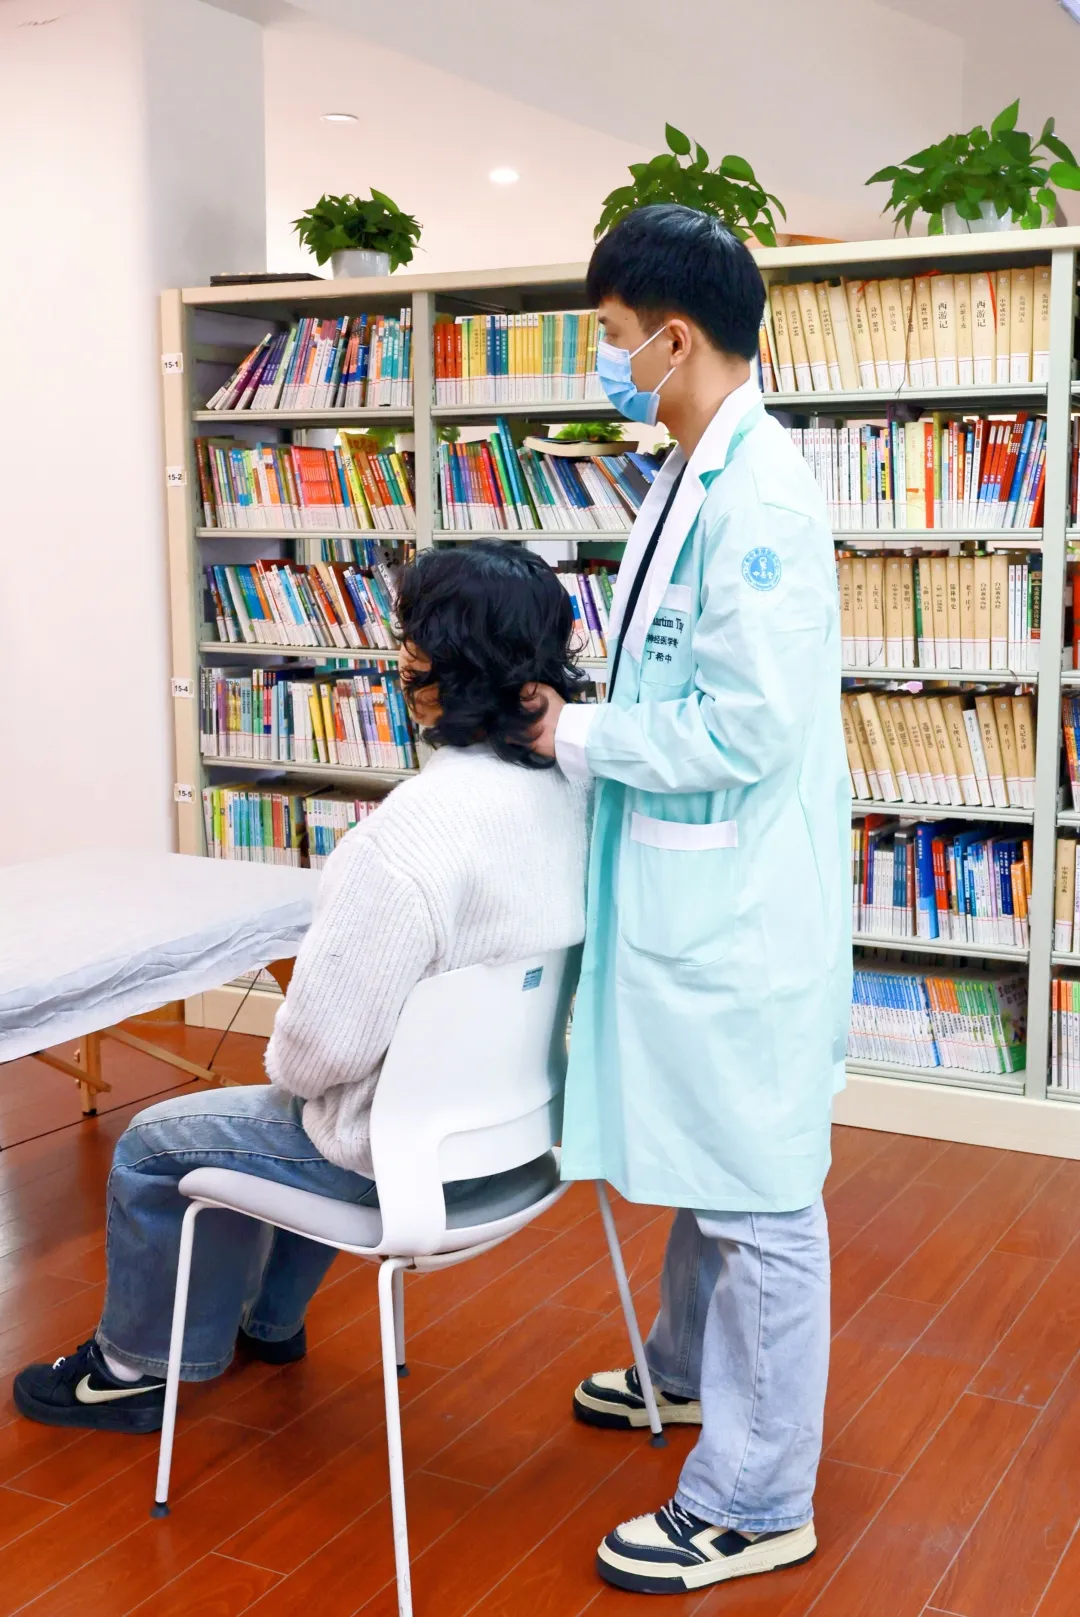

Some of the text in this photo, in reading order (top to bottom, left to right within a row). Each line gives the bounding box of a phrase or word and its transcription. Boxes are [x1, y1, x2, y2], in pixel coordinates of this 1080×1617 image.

[937, 301, 949, 329] 西游记
[976, 299, 987, 328] 西游记
[164, 361, 179, 369] 15-1
[167, 473, 182, 481] 15-2
[178, 789, 192, 798] 15-5
